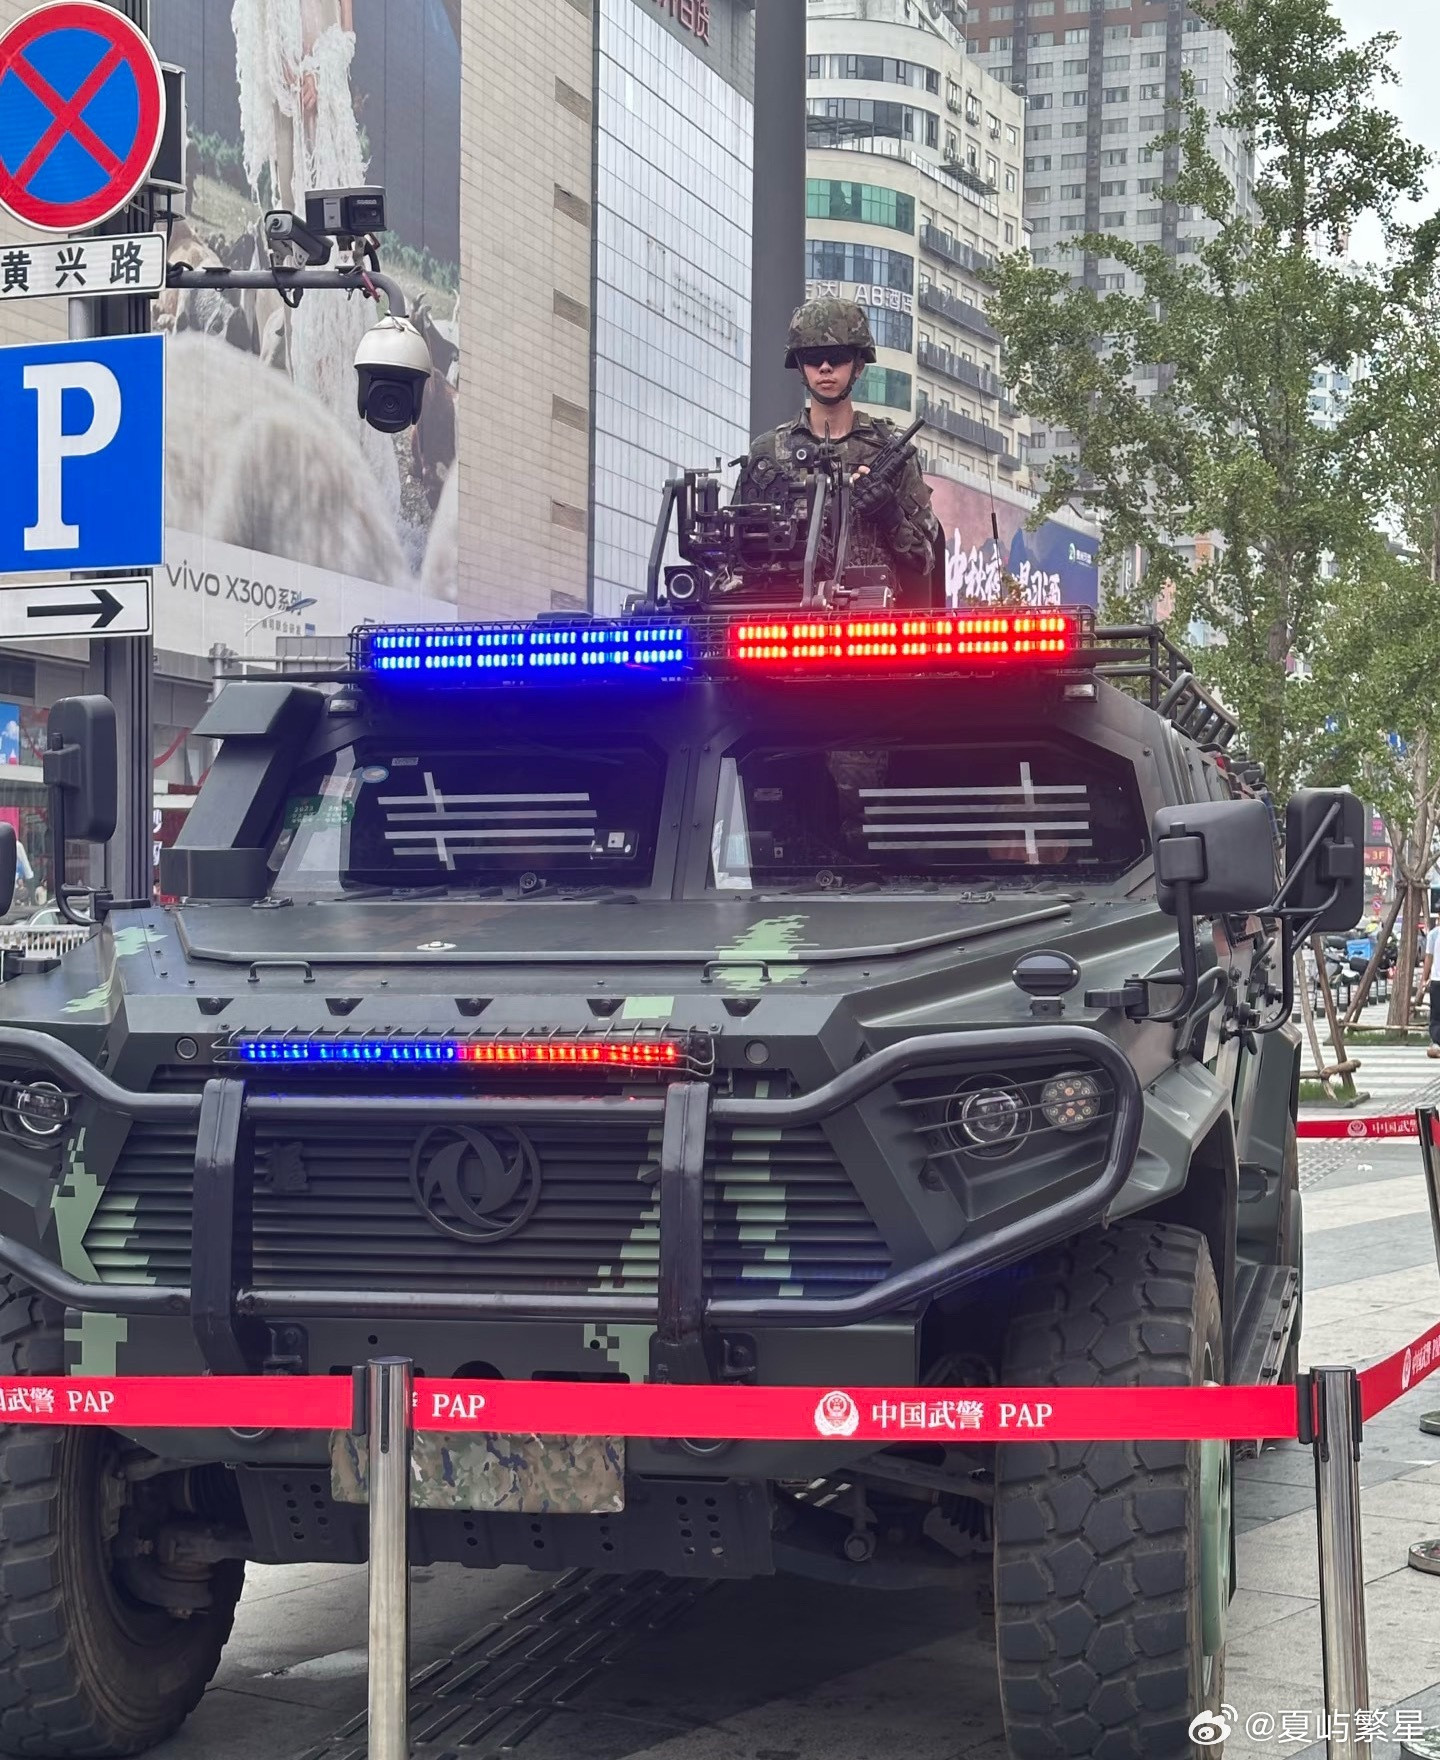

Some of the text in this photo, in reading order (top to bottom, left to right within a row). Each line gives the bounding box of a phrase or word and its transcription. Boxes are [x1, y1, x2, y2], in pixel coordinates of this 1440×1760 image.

[1, 241, 144, 293] 黄兴路
[23, 361, 122, 551] P
[166, 559, 220, 597] vivo
[0, 1387, 115, 1413] 武警 PAP
[431, 1393, 486, 1418] PAP
[872, 1400, 1053, 1429] 中国武警 PAP
